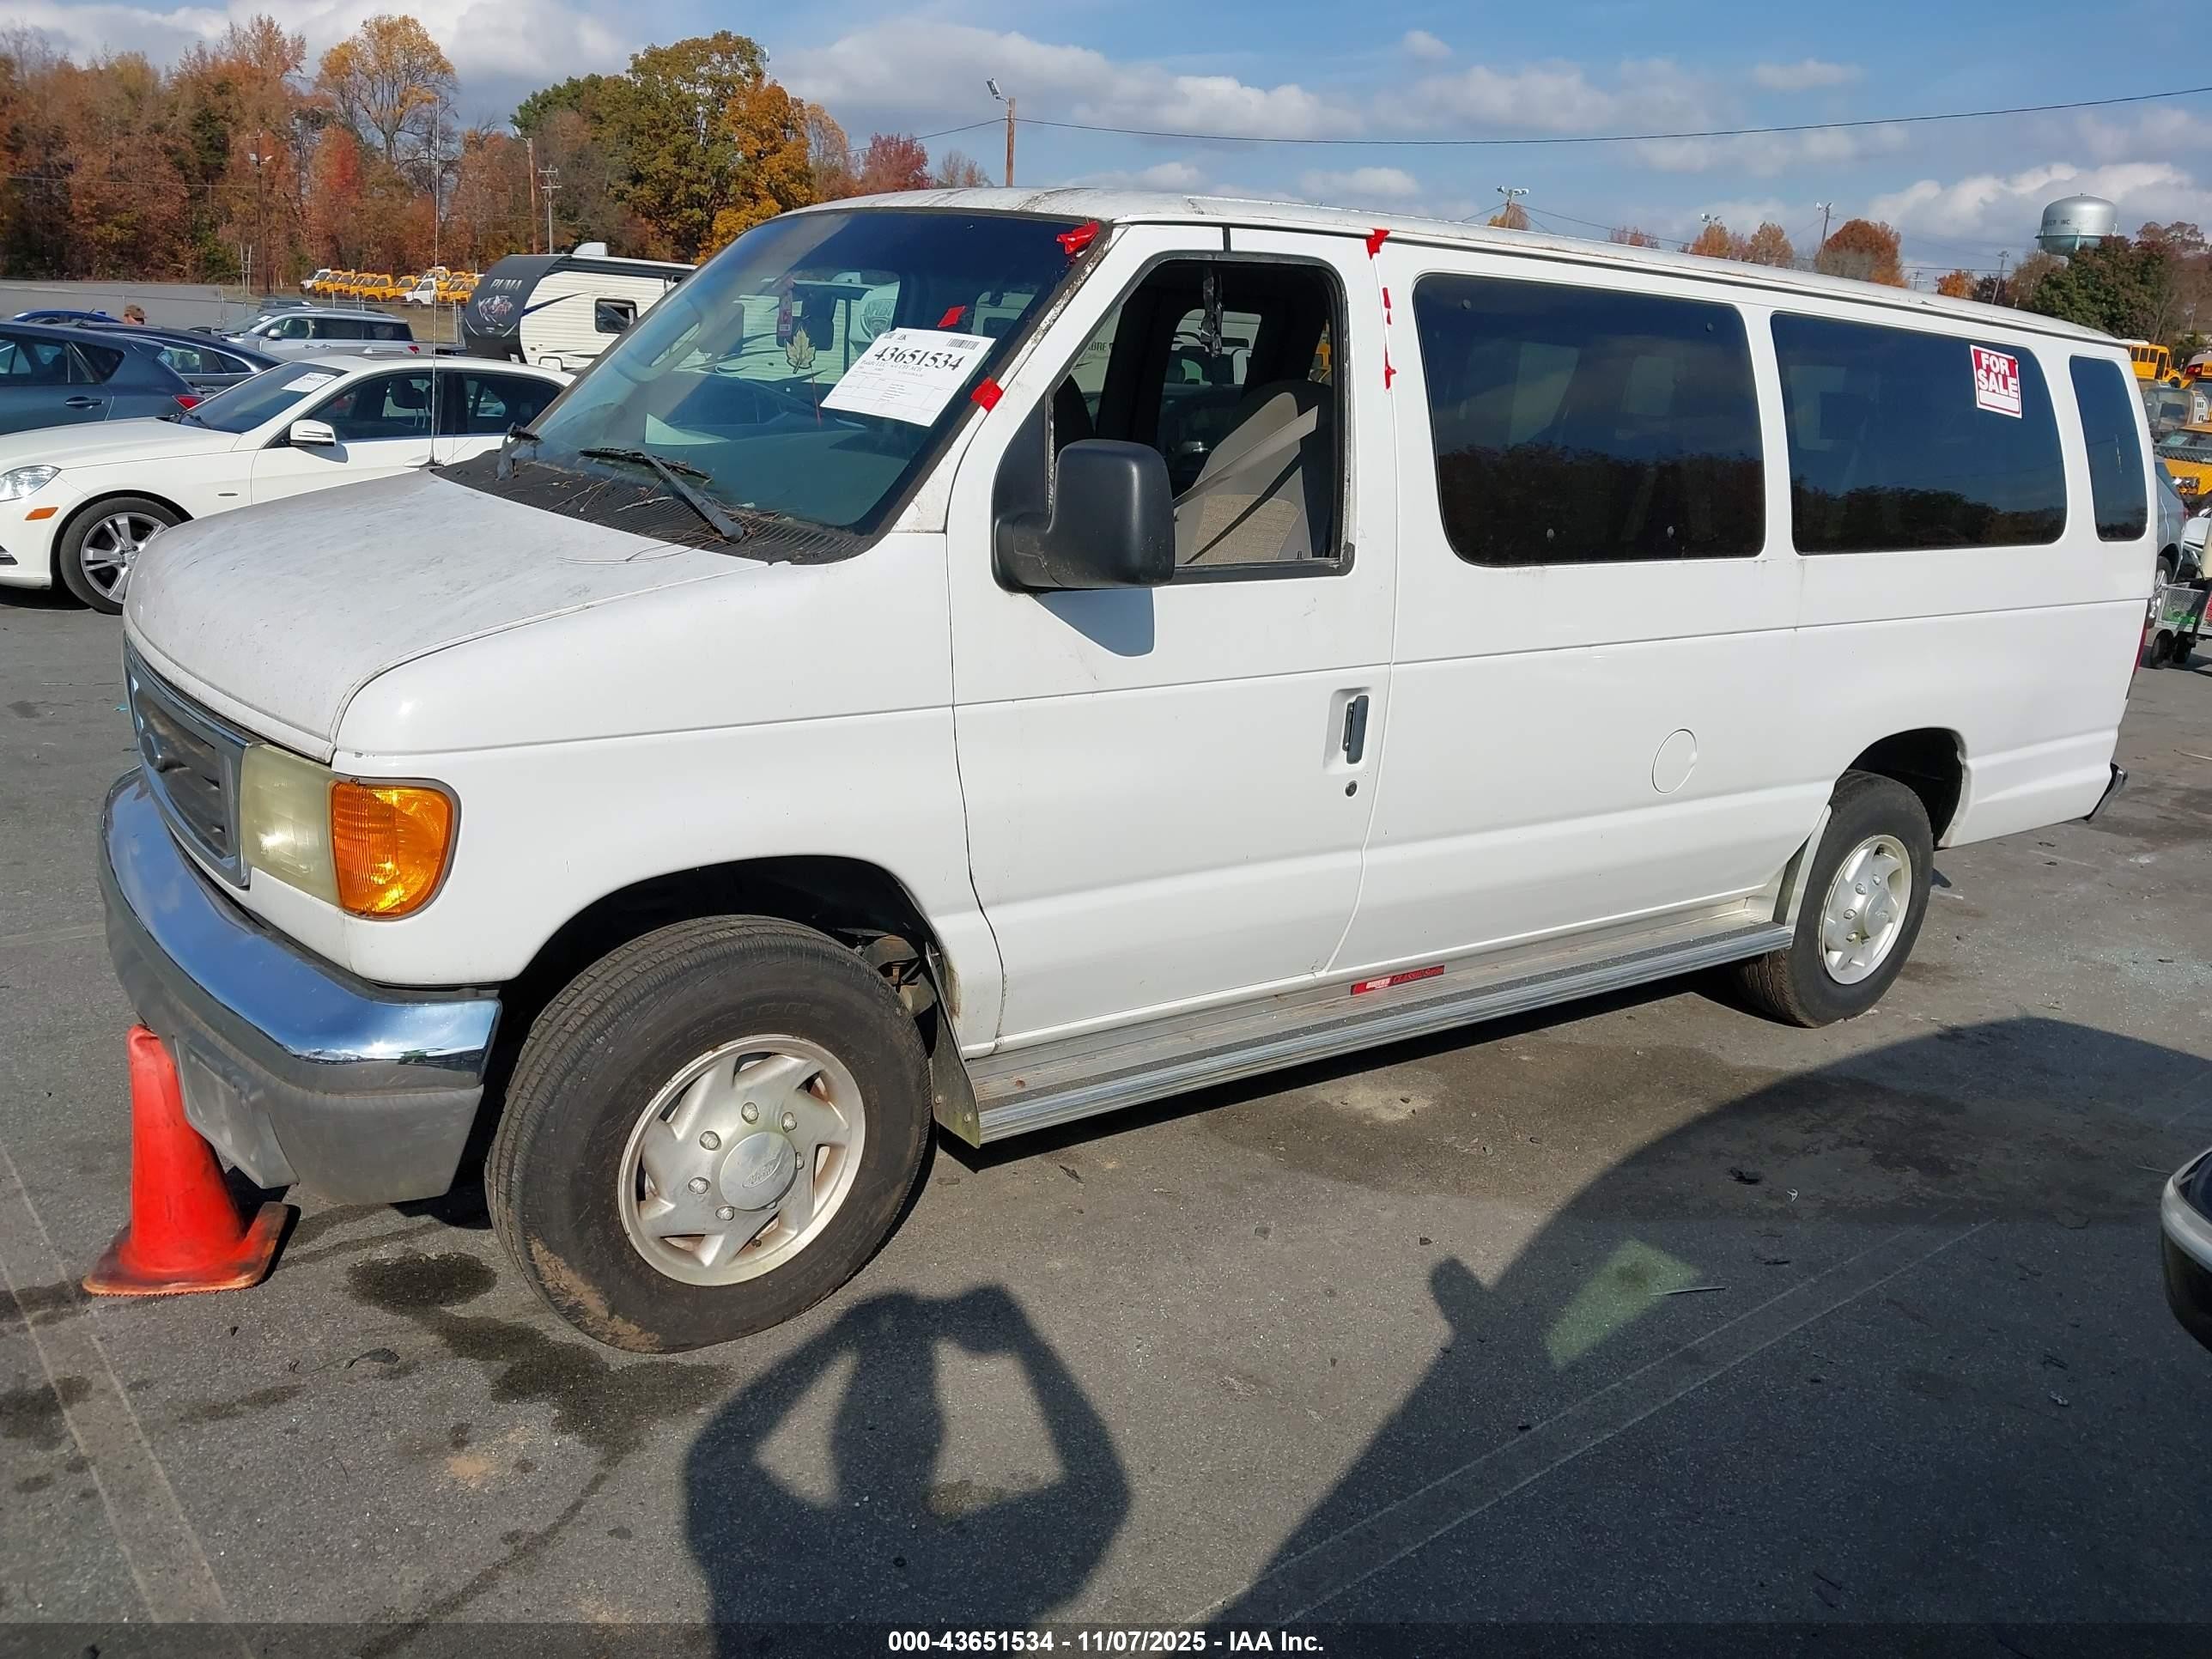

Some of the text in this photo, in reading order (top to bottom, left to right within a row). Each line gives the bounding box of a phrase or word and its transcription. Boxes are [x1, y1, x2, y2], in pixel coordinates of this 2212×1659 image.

[489, 278, 523, 289] PUMA
[874, 345, 965, 371] 43651534
[1980, 351, 2010, 376] FOR
[1977, 368, 2019, 398] SALE
